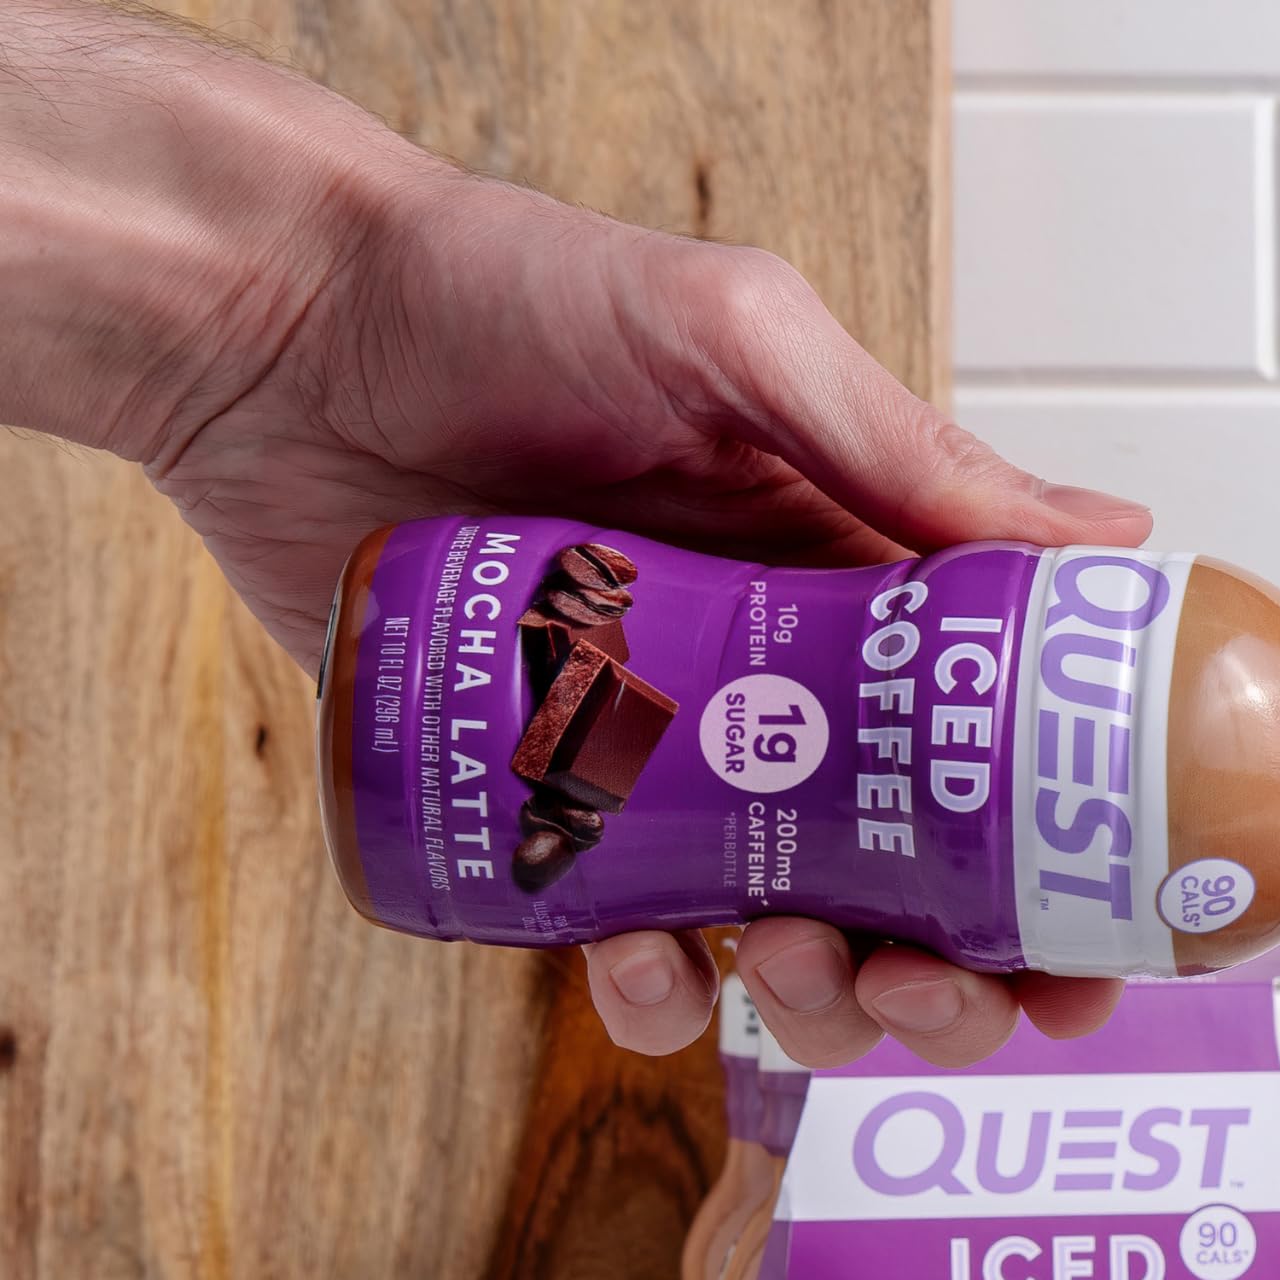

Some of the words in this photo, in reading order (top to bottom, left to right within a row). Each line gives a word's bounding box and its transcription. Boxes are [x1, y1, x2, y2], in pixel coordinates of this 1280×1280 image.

[451, 525, 480, 550] COFFEE
[434, 551, 469, 604] BEVERAGE
[384, 617, 410, 636] NET
[427, 607, 454, 670] FLAVORED
[454, 533, 521, 692] MOCHA
[750, 581, 767, 665] PROTEIN
[773, 604, 799, 643] 10g
[378, 659, 404, 671] FL
[380, 642, 406, 655] 10
[373, 694, 400, 723] (296
[377, 676, 402, 691] OZ
[423, 674, 443, 710] WITH
[371, 728, 399, 753] mL)
[421, 716, 440, 761] OTHER
[725, 693, 745, 773] SUGAR
[753, 704, 807, 763] 1g
[856, 581, 928, 858] COFFEE
[930, 617, 1004, 814] ICED
[1035, 555, 1170, 921] QUEST
[421, 767, 442, 831] NATURAL
[451, 719, 494, 879] LATTE
[424, 836, 450, 891] FLAVORS
[724, 842, 736, 888] BOTTLE
[772, 809, 797, 891] 200mg
[1202, 875, 1236, 916] 90
[852, 1091, 1251, 1197] QUEST
[1199, 1222, 1236, 1247] 90
